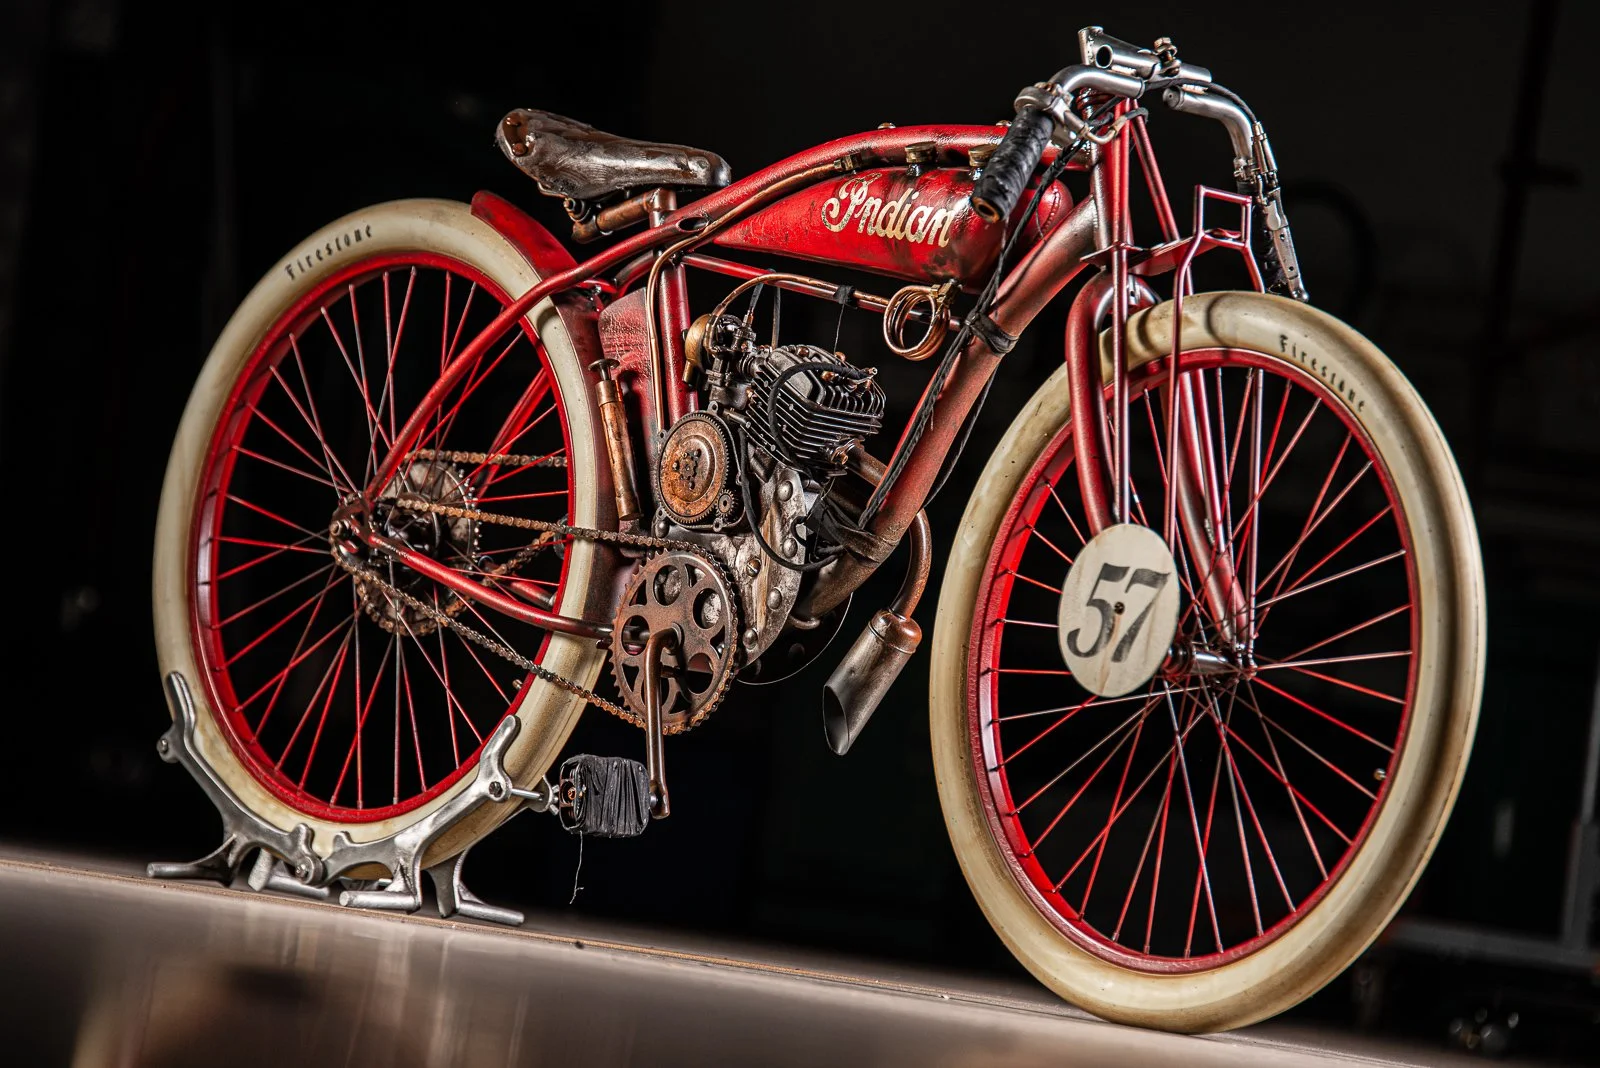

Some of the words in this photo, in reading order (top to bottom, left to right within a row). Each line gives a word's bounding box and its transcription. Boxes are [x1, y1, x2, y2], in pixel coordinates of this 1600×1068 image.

[821, 172, 955, 248] Indian
[284, 224, 372, 280] Firestone
[1279, 334, 1365, 412] Firestone
[1066, 562, 1172, 663] 57
